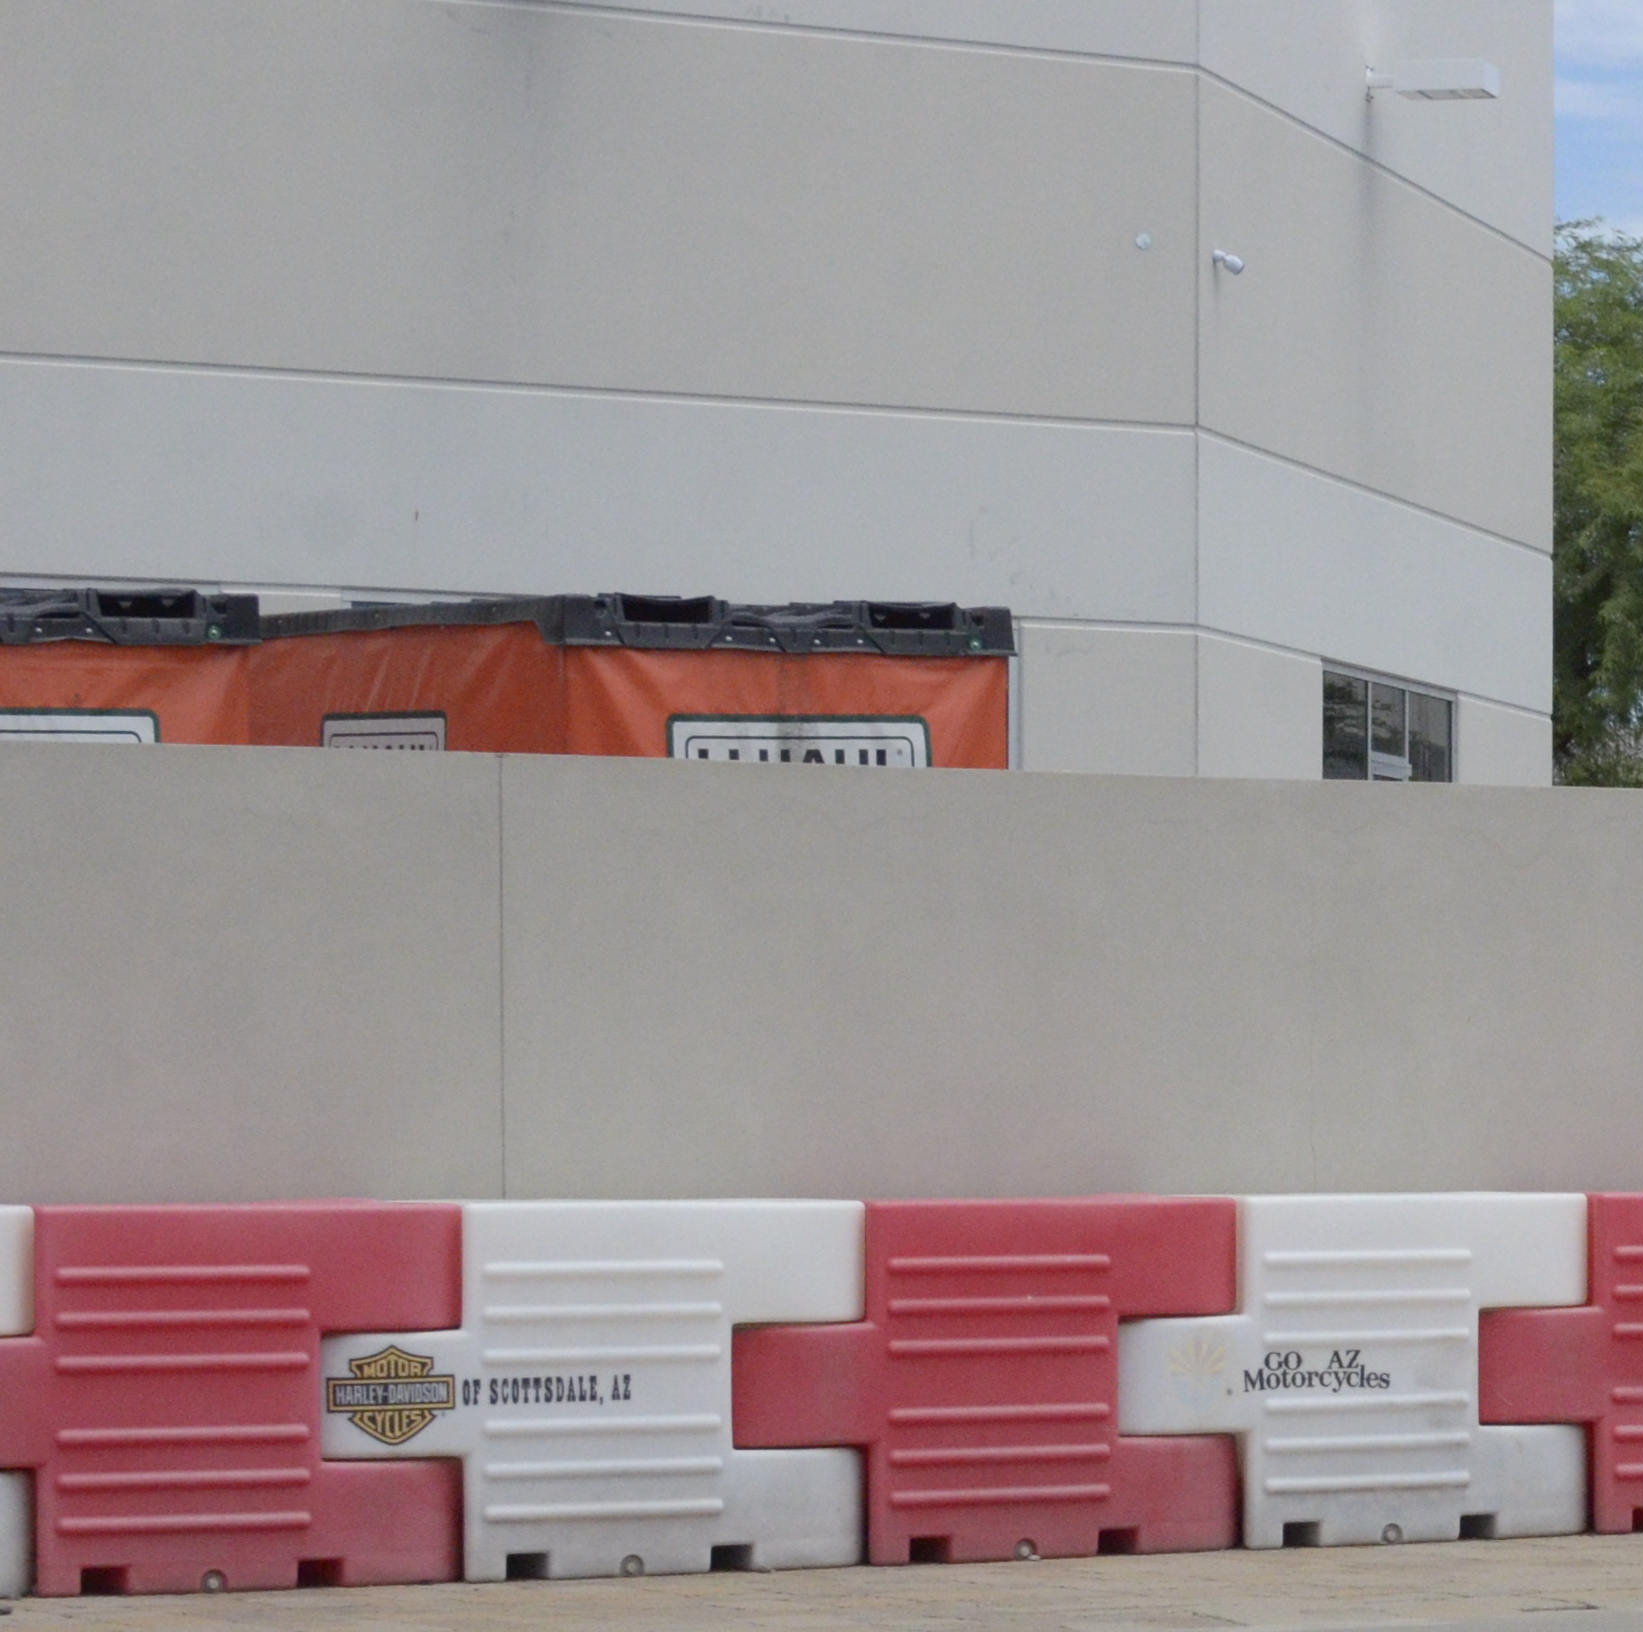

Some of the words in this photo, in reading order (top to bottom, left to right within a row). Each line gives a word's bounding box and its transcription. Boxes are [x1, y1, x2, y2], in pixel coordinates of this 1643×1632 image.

[363, 1355, 422, 1378] MOTOR
[1264, 1351, 1303, 1371] GO
[1327, 1349, 1361, 1370] AZ
[462, 1379, 482, 1406] OF
[490, 1374, 604, 1406] SCOTTSDALE,
[611, 1373, 632, 1400] AZ
[1243, 1364, 1391, 1393] Motorcycles
[335, 1382, 449, 1405] HARLEY-DAVIDSON
[363, 1409, 423, 1438] CYCLES
